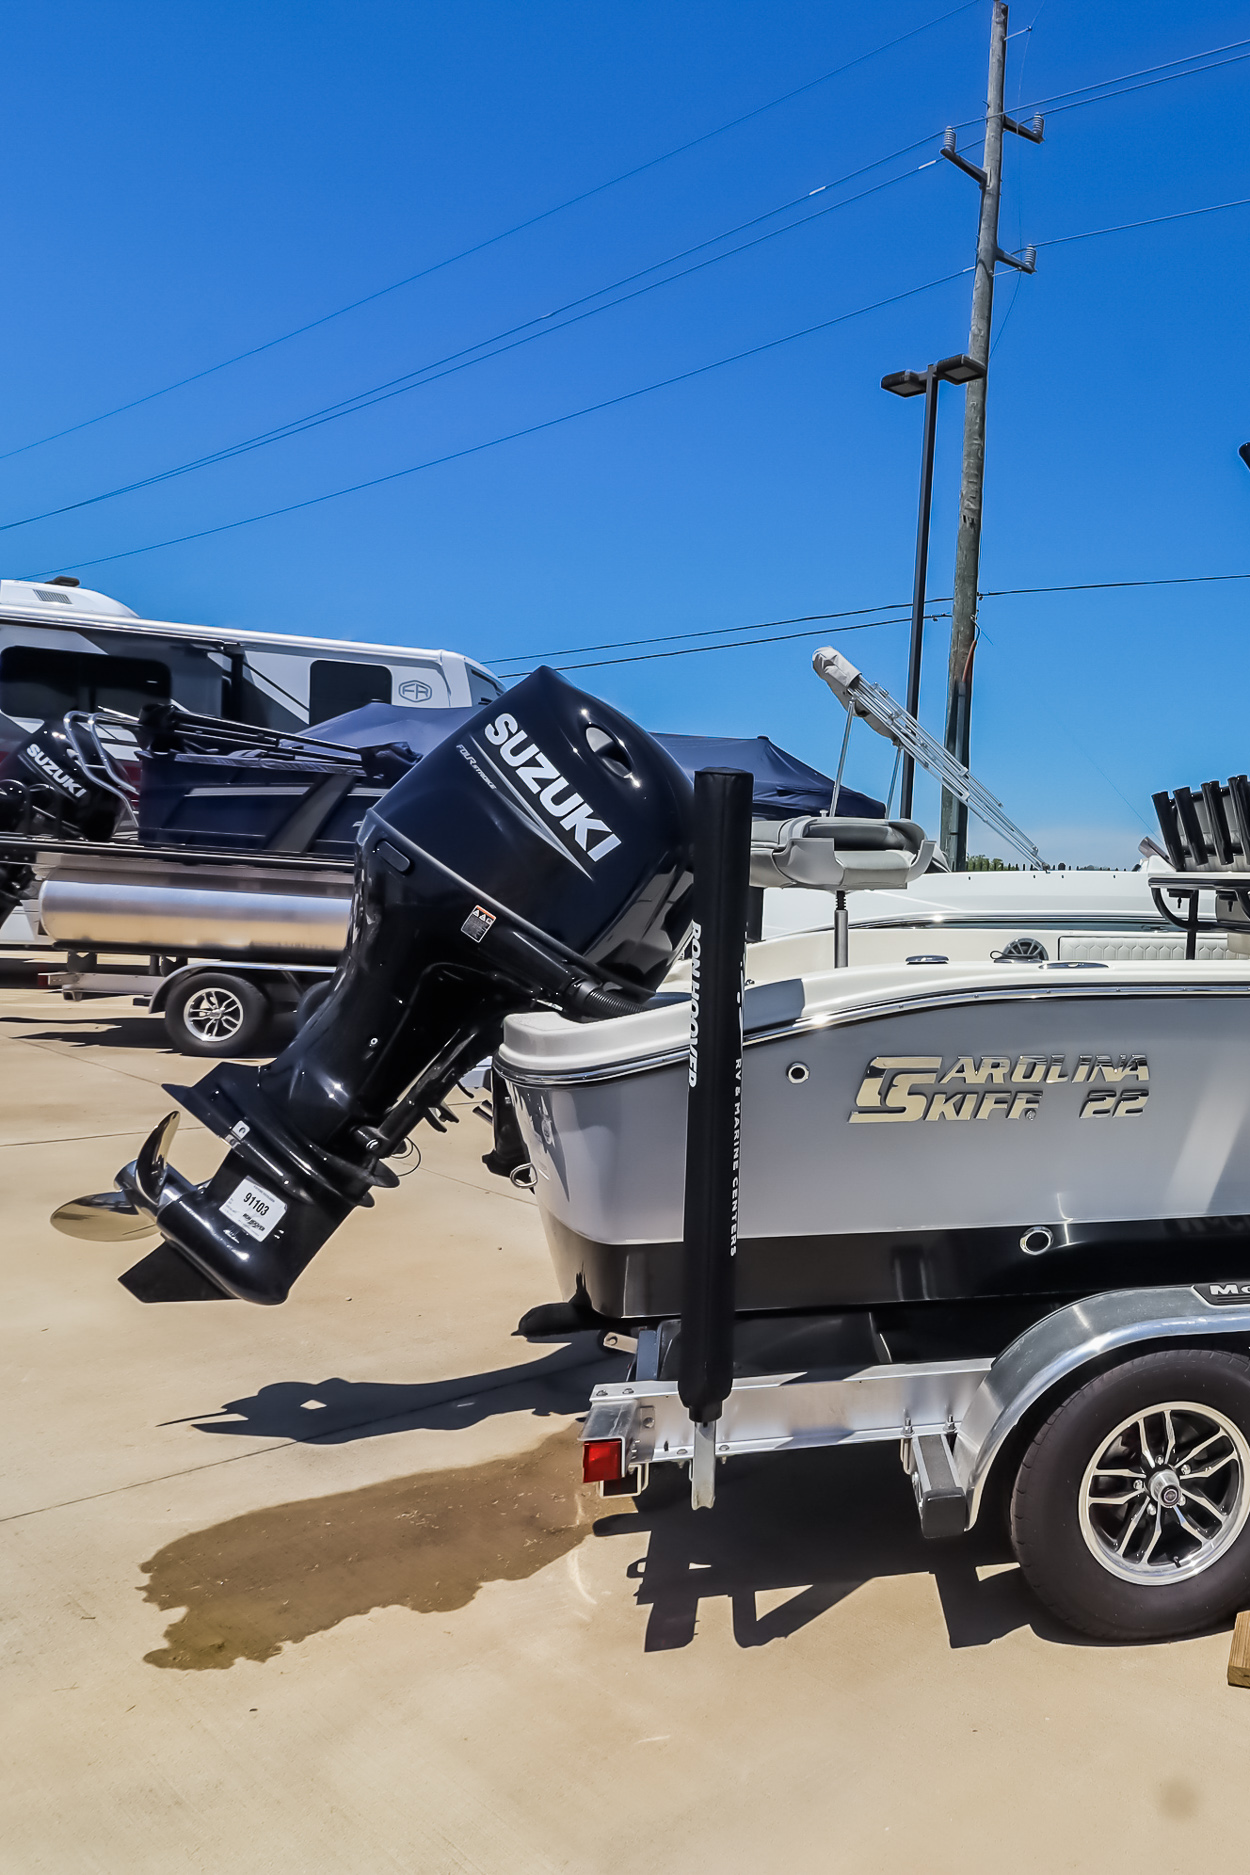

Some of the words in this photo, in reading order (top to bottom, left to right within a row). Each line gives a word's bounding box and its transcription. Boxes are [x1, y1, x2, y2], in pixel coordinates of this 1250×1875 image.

[26, 743, 87, 798] SUZUKI
[456, 743, 477, 766] FOUR
[484, 712, 622, 862] SUZUKI
[734, 1058, 742, 1080] RV
[734, 1086, 741, 1097] &
[855, 1053, 1151, 1107] CAROLINA
[847, 1072, 1043, 1124] SKIFF
[1078, 1089, 1150, 1120] 22
[732, 1102, 741, 1171] MARINE
[243, 1192, 270, 1216] 91103
[729, 1176, 739, 1257] CENTERS
